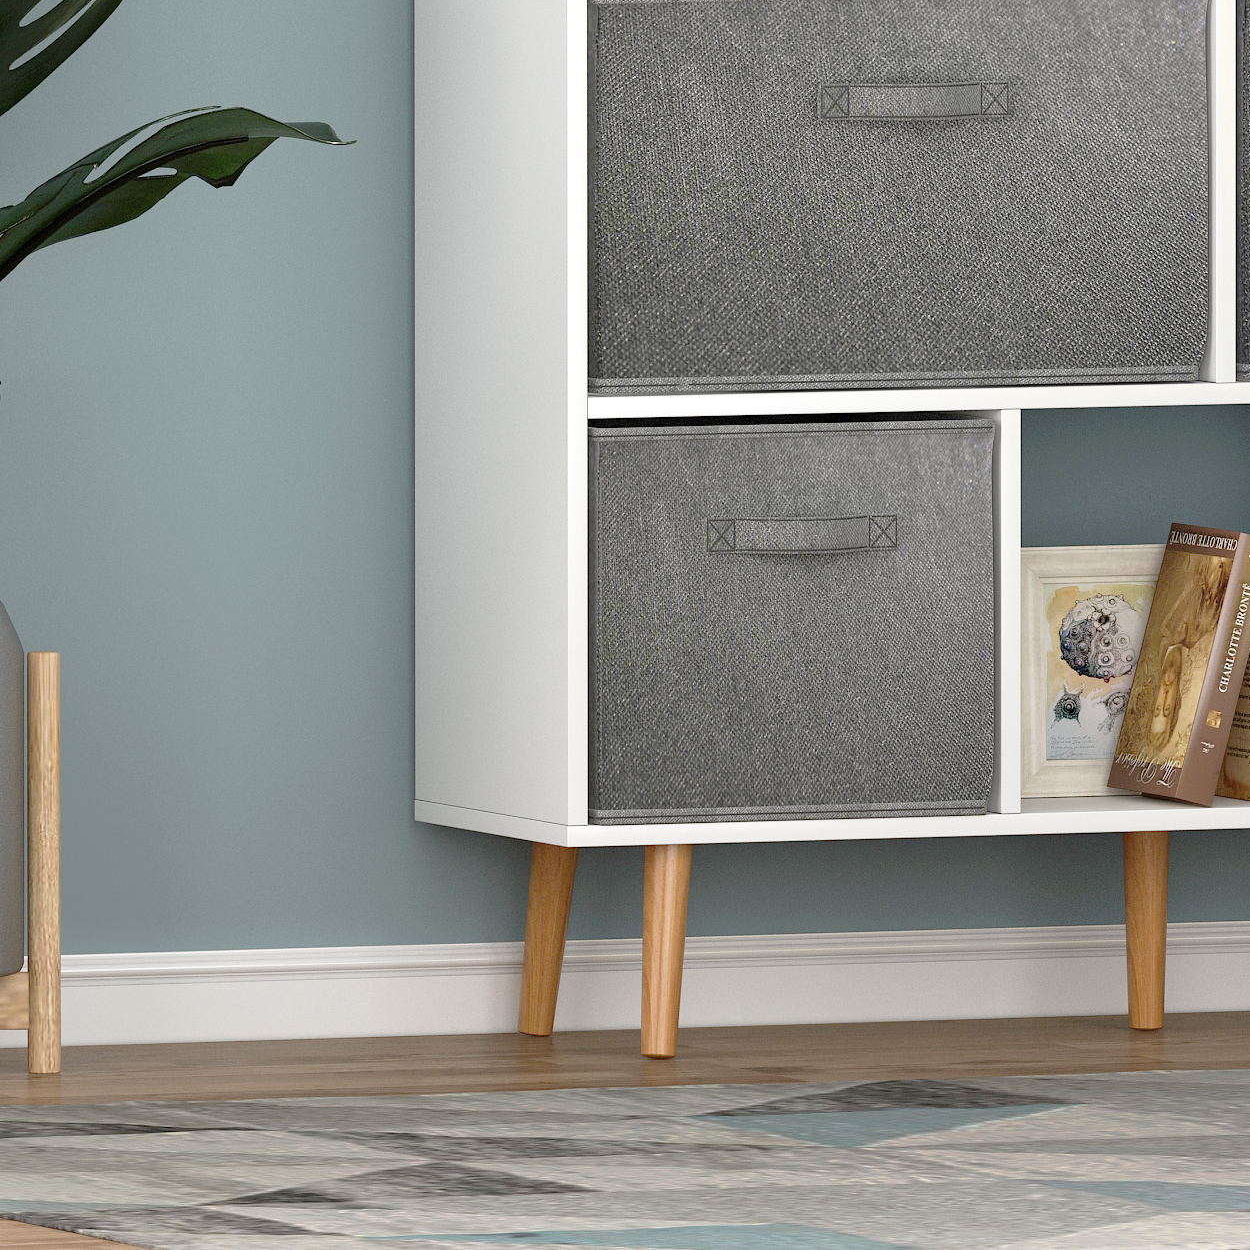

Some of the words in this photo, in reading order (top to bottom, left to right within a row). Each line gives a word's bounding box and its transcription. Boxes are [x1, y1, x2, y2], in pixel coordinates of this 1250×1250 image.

[1170, 530, 1197, 545] BRONTË
[1196, 534, 1238, 551] CHARLOTTE
[1219, 628, 1243, 693] CHARLOTTE
